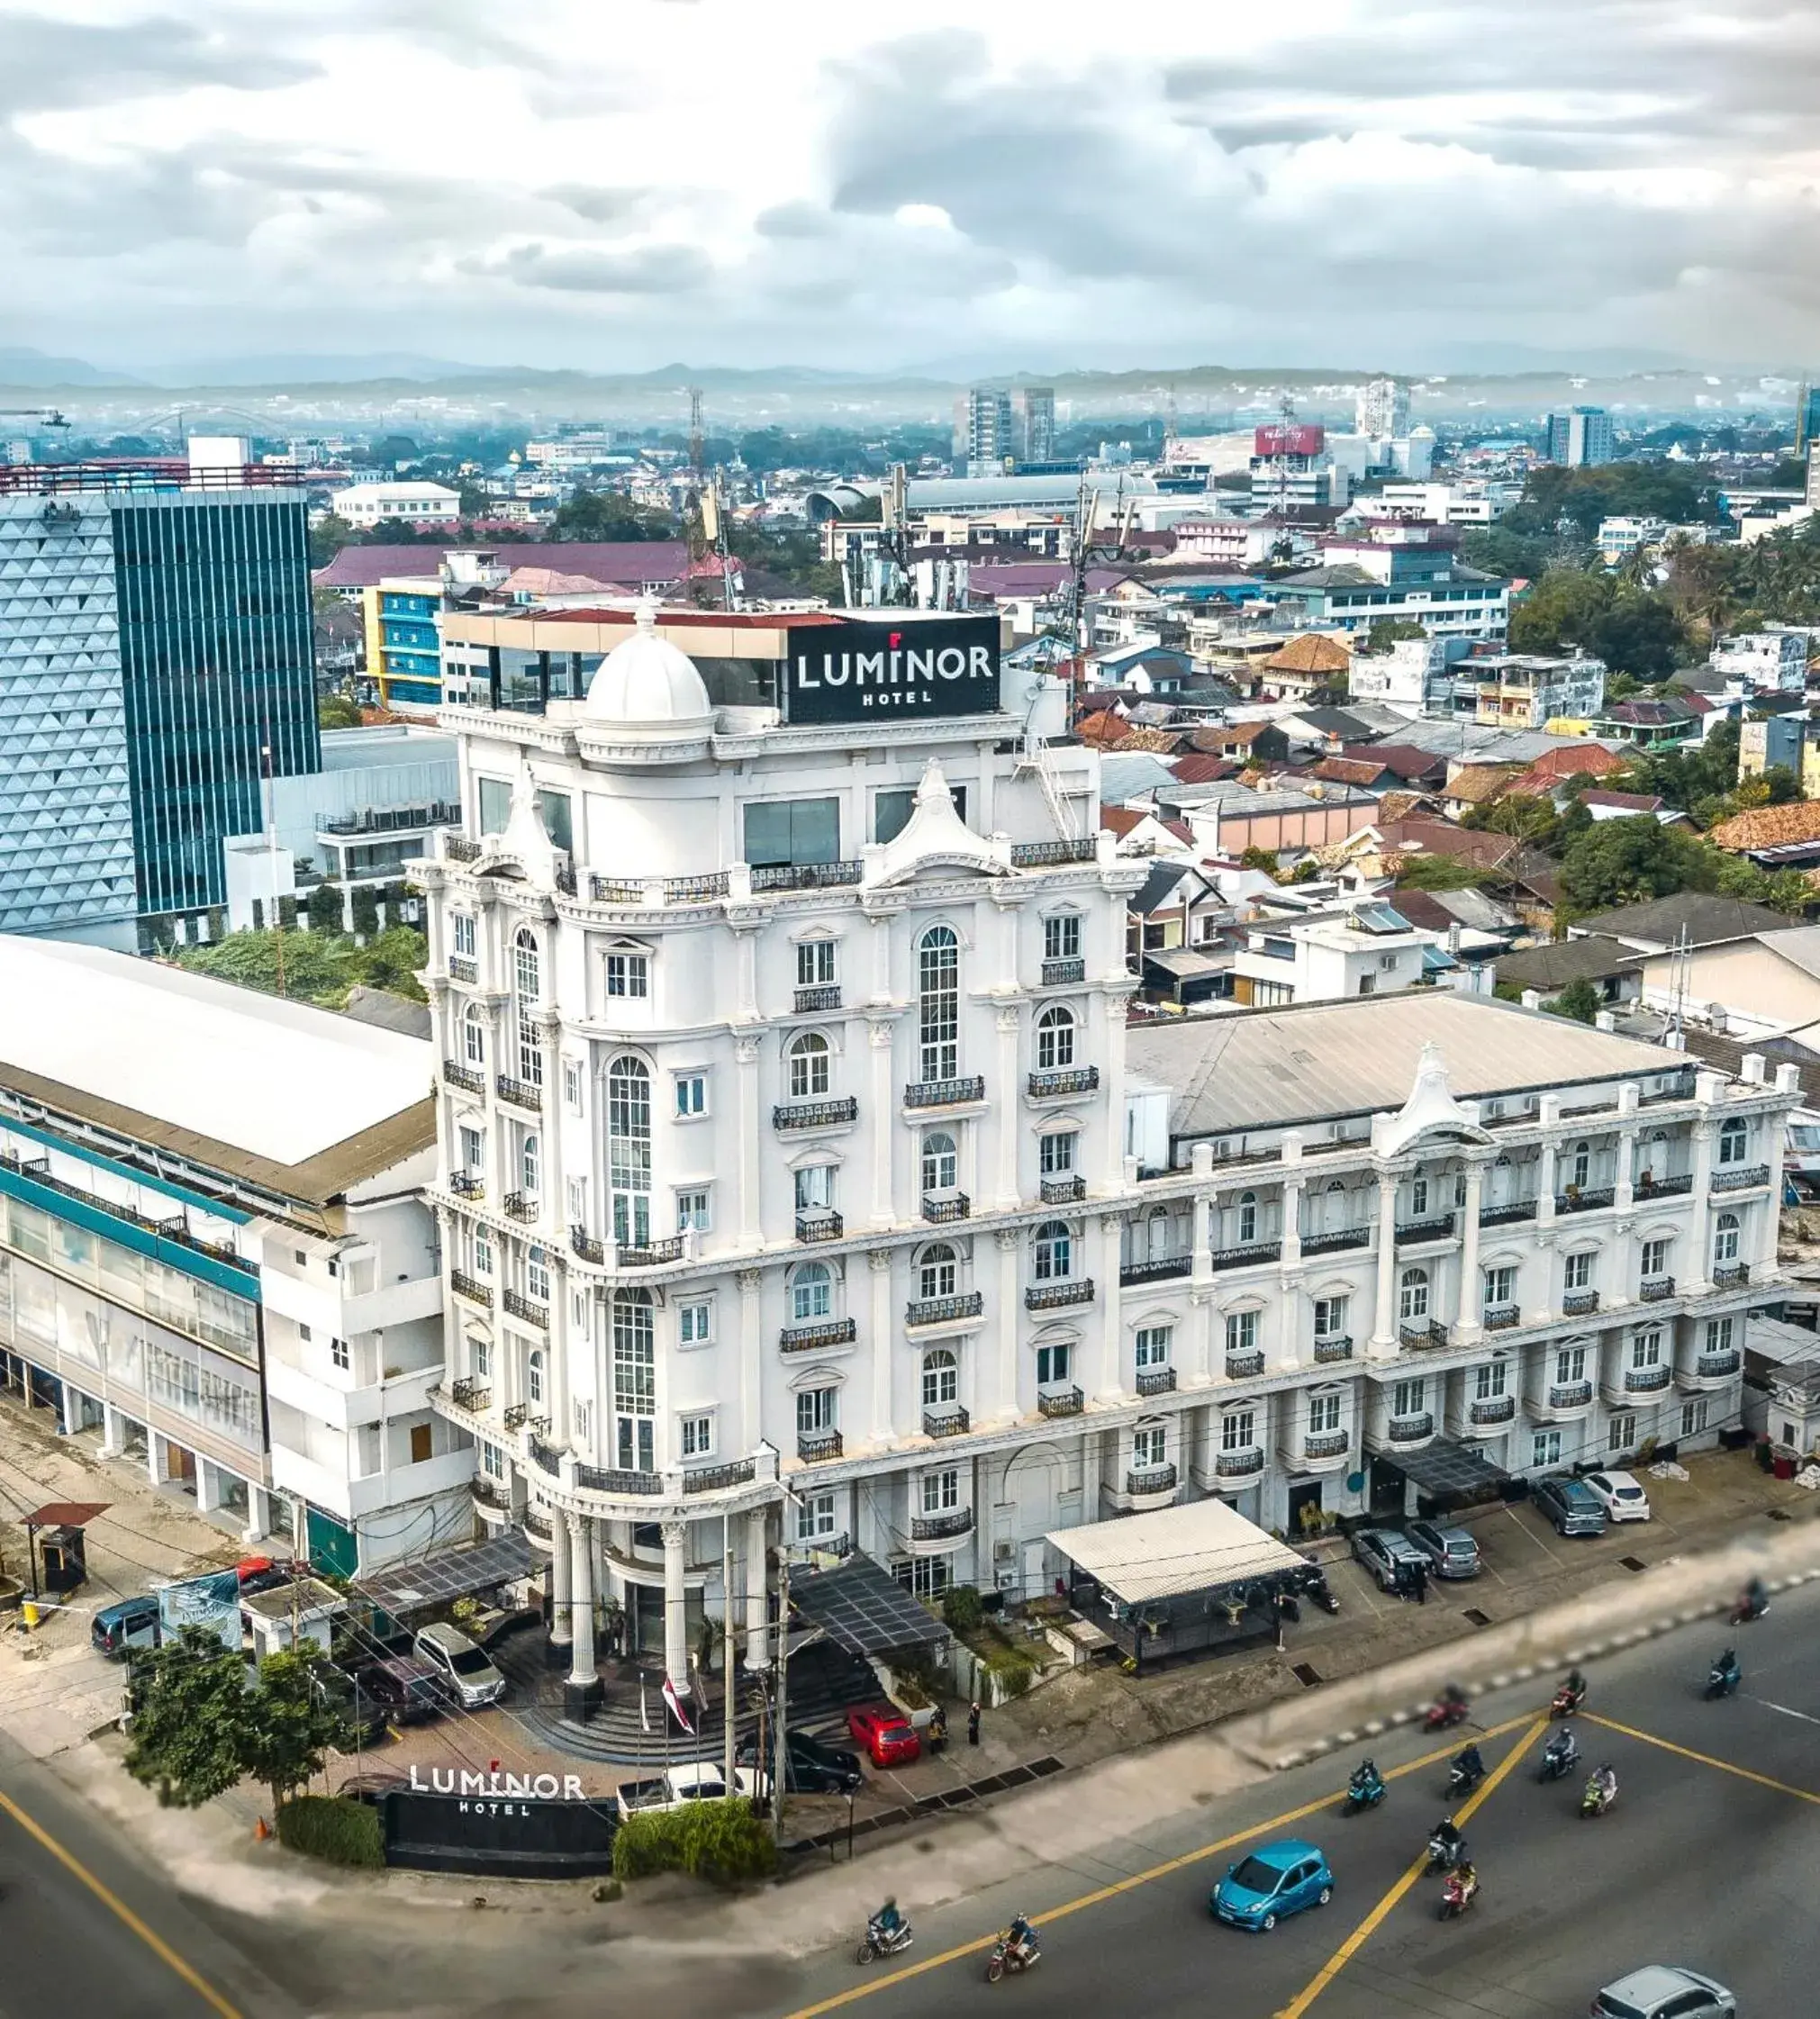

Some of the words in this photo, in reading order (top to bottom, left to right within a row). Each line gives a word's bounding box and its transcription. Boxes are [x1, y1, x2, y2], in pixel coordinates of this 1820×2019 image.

[798, 632, 993, 688] LUMINOR
[863, 691, 932, 706] HOTEL
[410, 1760, 585, 1799] LUMINOR
[459, 1801, 530, 1816] HOTEL
